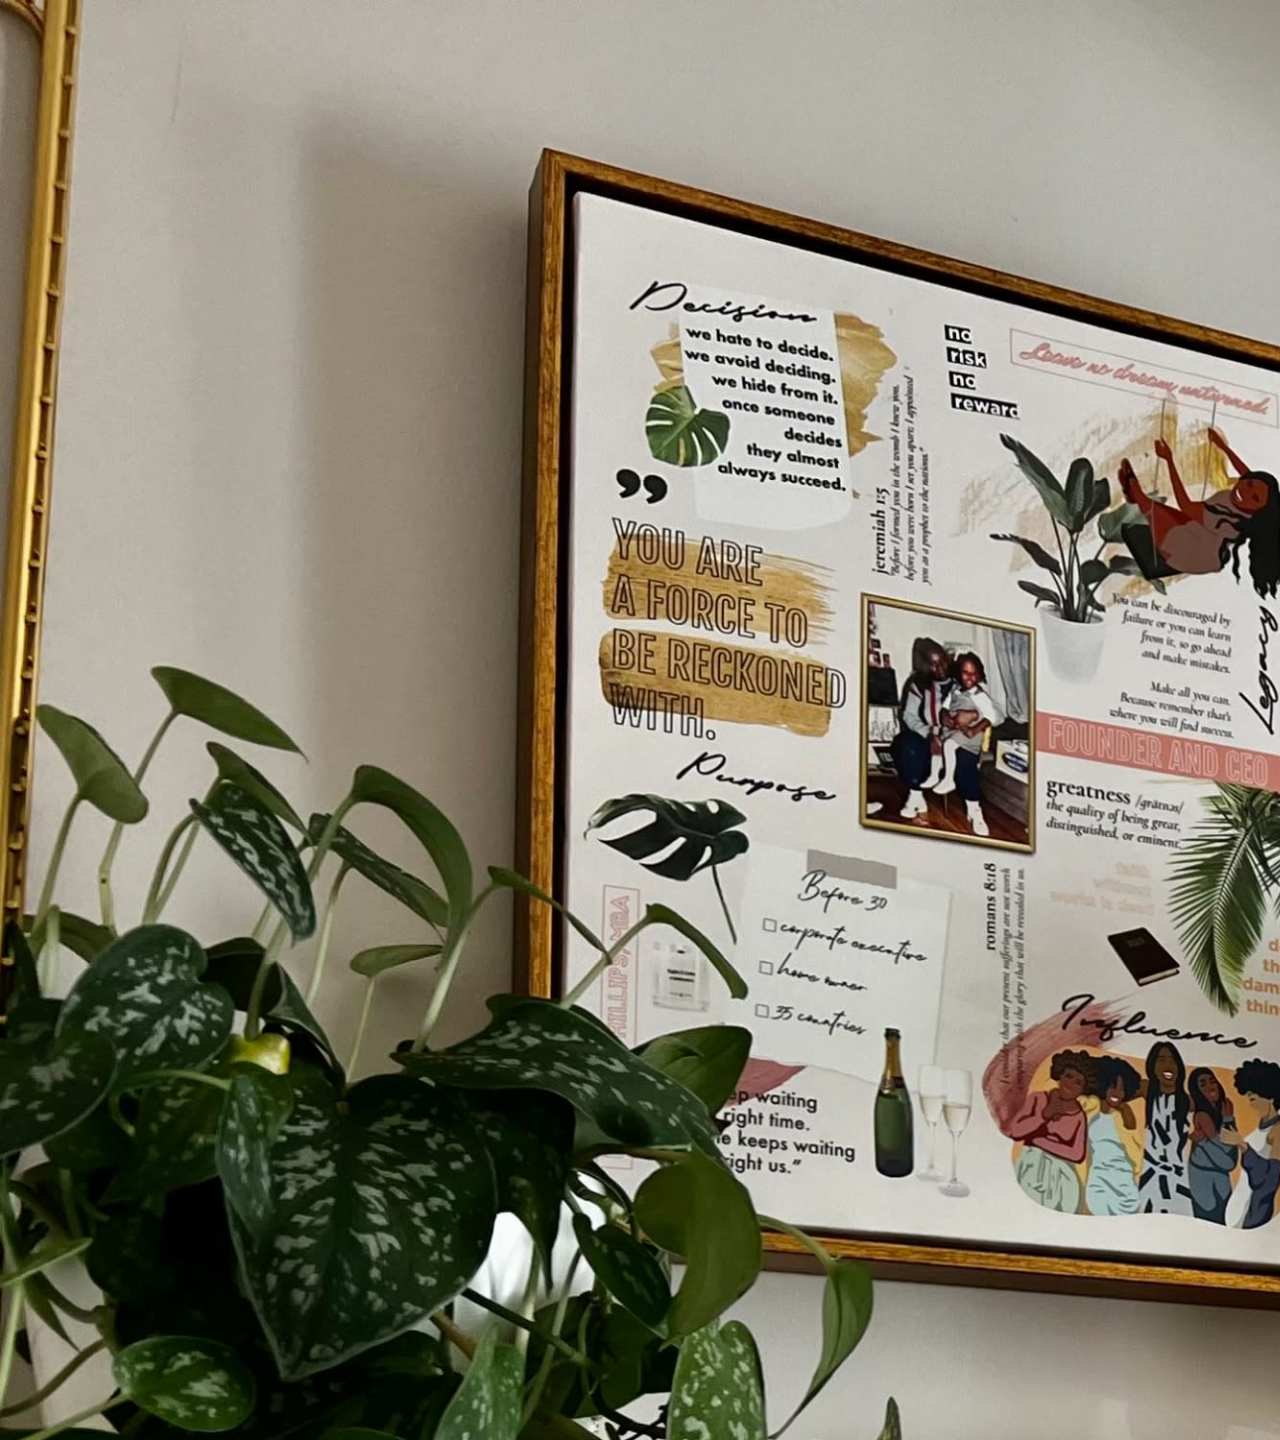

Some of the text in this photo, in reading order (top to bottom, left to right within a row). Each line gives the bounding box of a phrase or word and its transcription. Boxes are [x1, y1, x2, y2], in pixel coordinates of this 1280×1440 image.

[629, 281, 817, 322] Decision
[685, 327, 834, 362] we hate to decide.
[949, 349, 987, 368] risk
[685, 349, 837, 385] we avoid deciding.
[1086, 360, 1113, 376] no
[712, 374, 839, 405] we hide from it.
[722, 398, 835, 426] once someone
[784, 427, 843, 448] decides
[747, 444, 840, 469] they almost
[718, 462, 846, 491] always succeed.
[870, 487, 890, 576] jeremiah 1:5
[612, 517, 764, 587] YOU ARE
[611, 574, 808, 649] A FORCE TO
[1112, 592, 1231, 628] You can be discouraged by
[1121, 610, 1231, 641] failure or you can learn
[612, 628, 847, 709] BE RECKONED
[609, 683, 717, 741] WITH.
[1049, 718, 1269, 787] FOUNDER AND CEO
[676, 751, 837, 802] Purpose
[1046, 779, 1131, 805] greatness
[1046, 799, 1182, 833] the quality of being great,
[1046, 816, 1118, 840] distinguished,
[1122, 831, 1134, 841] or
[797, 869, 888, 914] Before 30
[983, 862, 997, 951] romans 8:18
[609, 895, 629, 941] MBA
[780, 926, 848, 950] corporate
[777, 952, 820, 983] home
[771, 1005, 867, 1036] 35 countries
[1061, 993, 1258, 1048] Influence
[756, 1091, 818, 1114] waiting
[724, 1108, 811, 1131] right time.
[738, 1130, 788, 1154] keeps
[793, 1140, 856, 1163] waiting
